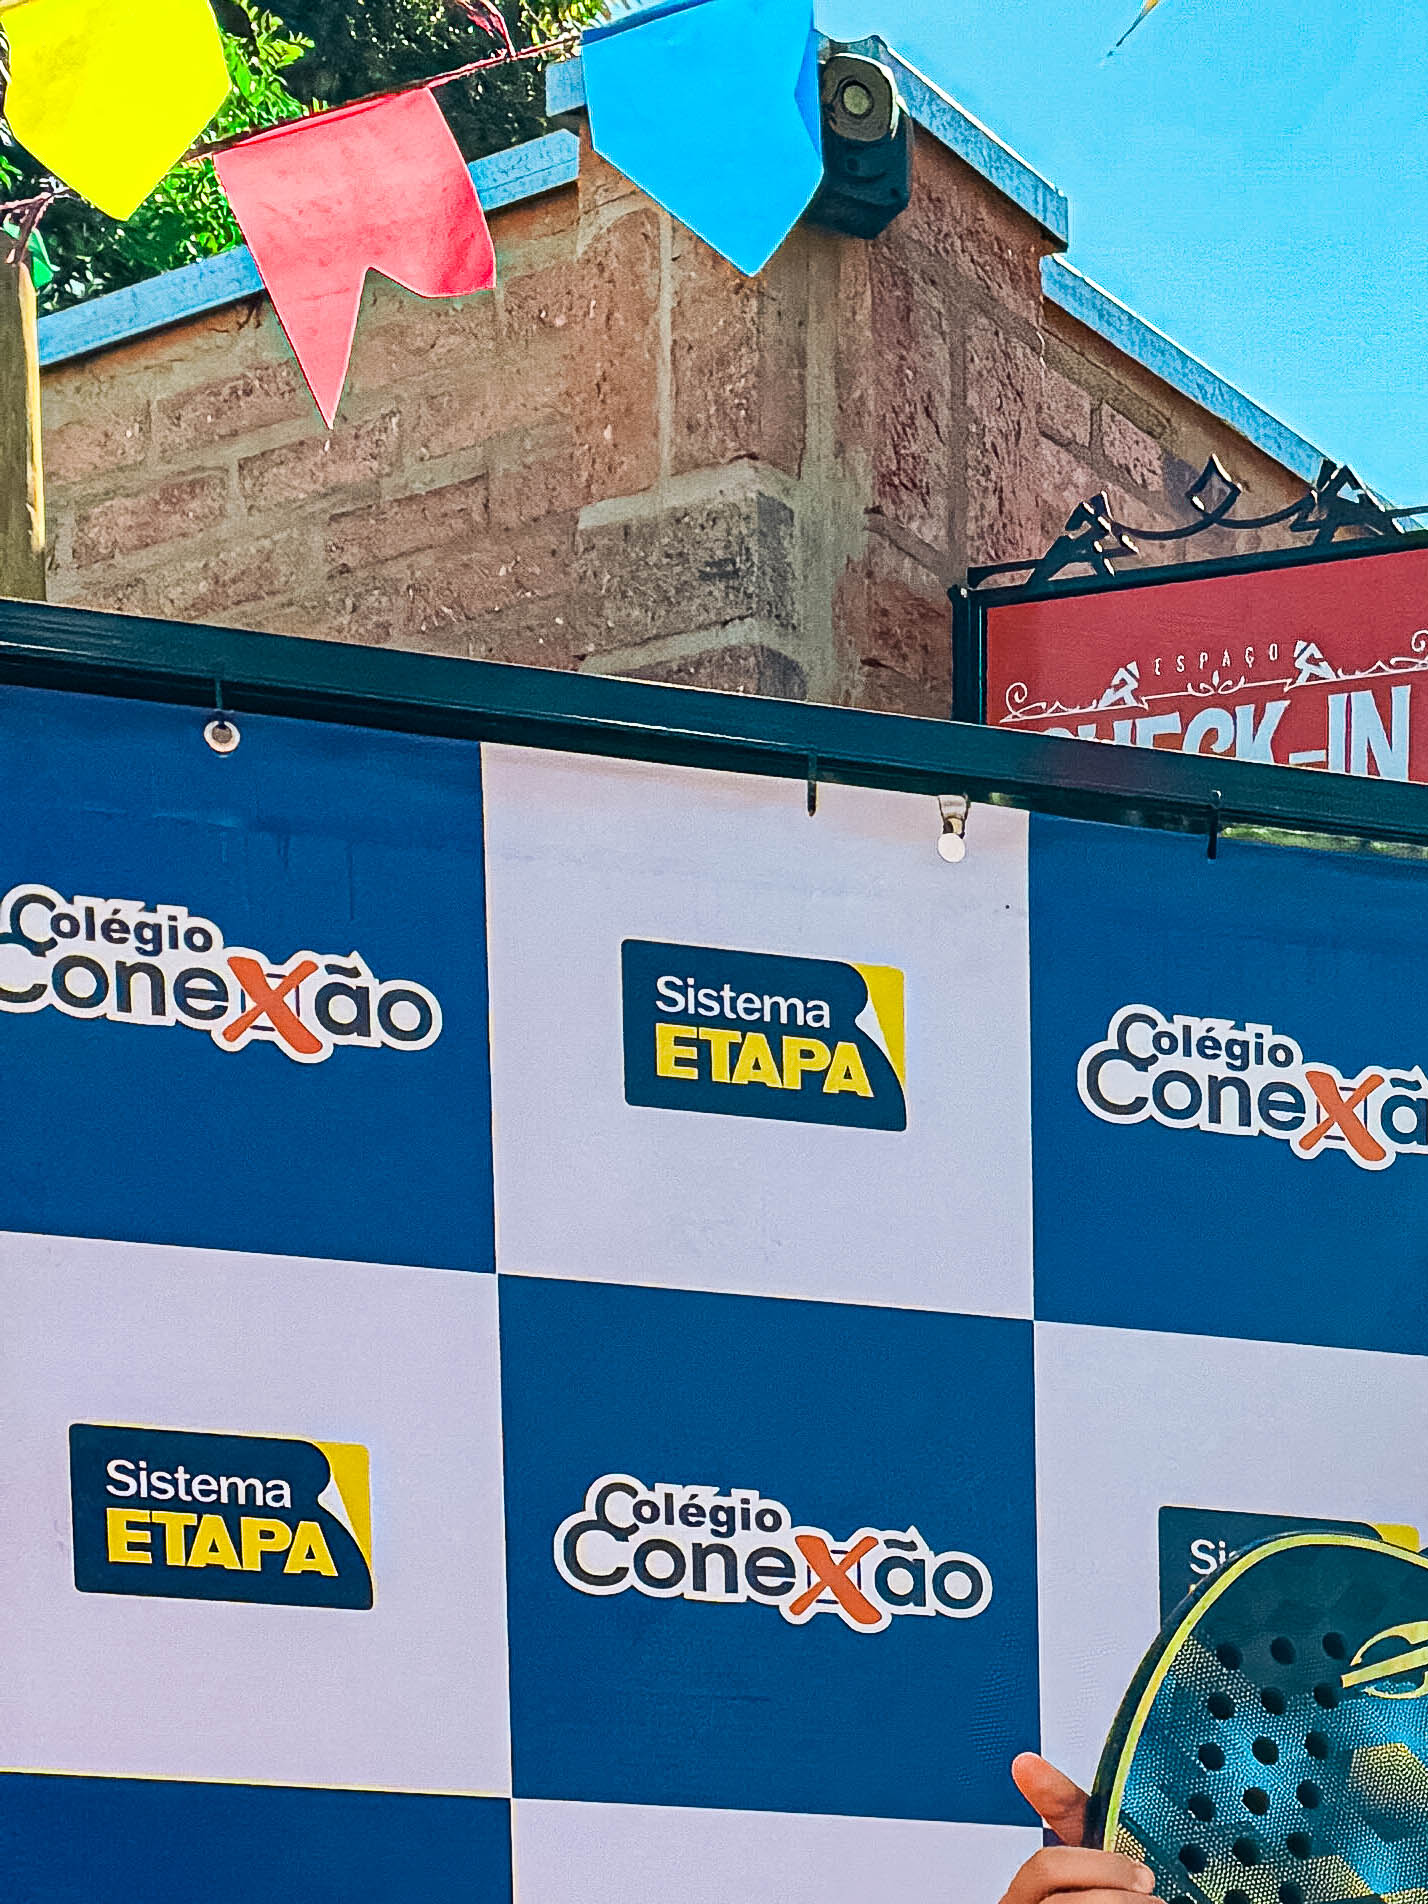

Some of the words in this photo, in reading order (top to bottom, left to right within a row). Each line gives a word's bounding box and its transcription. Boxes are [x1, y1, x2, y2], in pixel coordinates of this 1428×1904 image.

[1154, 644, 1278, 676] ESPAÇO
[9, 893, 214, 957] Colégio
[655, 975, 832, 1030] Sistema
[655, 1022, 874, 1098] ETAPA
[1115, 1014, 1294, 1071] Colégio
[105, 1459, 292, 1509] Sistema
[597, 1482, 782, 1543] Colégio
[105, 1508, 338, 1577] ETAPA
